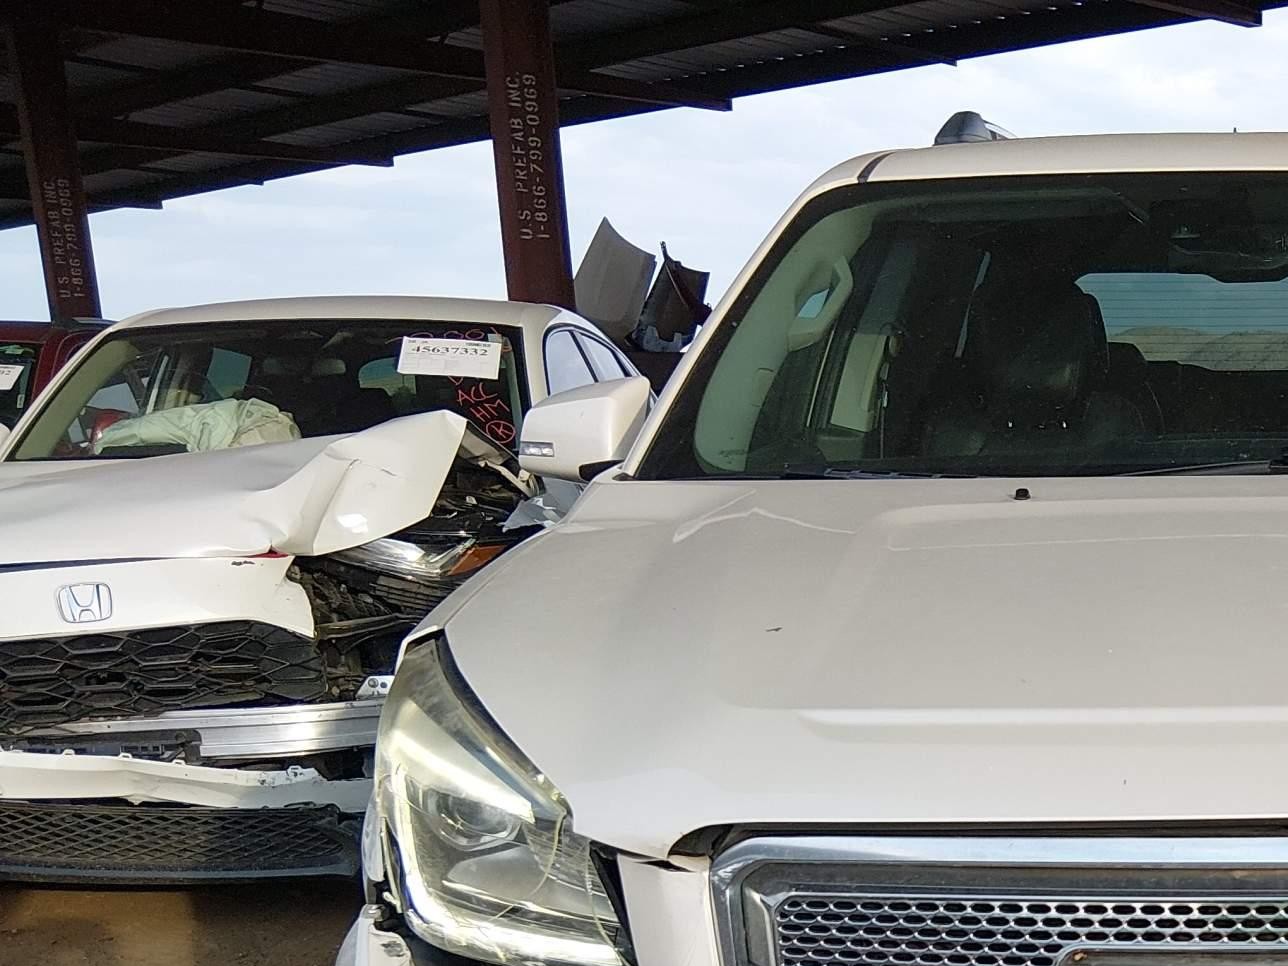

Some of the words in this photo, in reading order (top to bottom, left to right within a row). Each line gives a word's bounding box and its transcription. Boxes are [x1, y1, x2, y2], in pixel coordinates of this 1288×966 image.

[505, 71, 522, 107] INC.
[509, 117, 529, 193] PREFAB
[522, 73, 550, 239] 1-866-799-0969
[47, 210, 67, 264] PREFAB
[411, 345, 489, 356] 45637332
